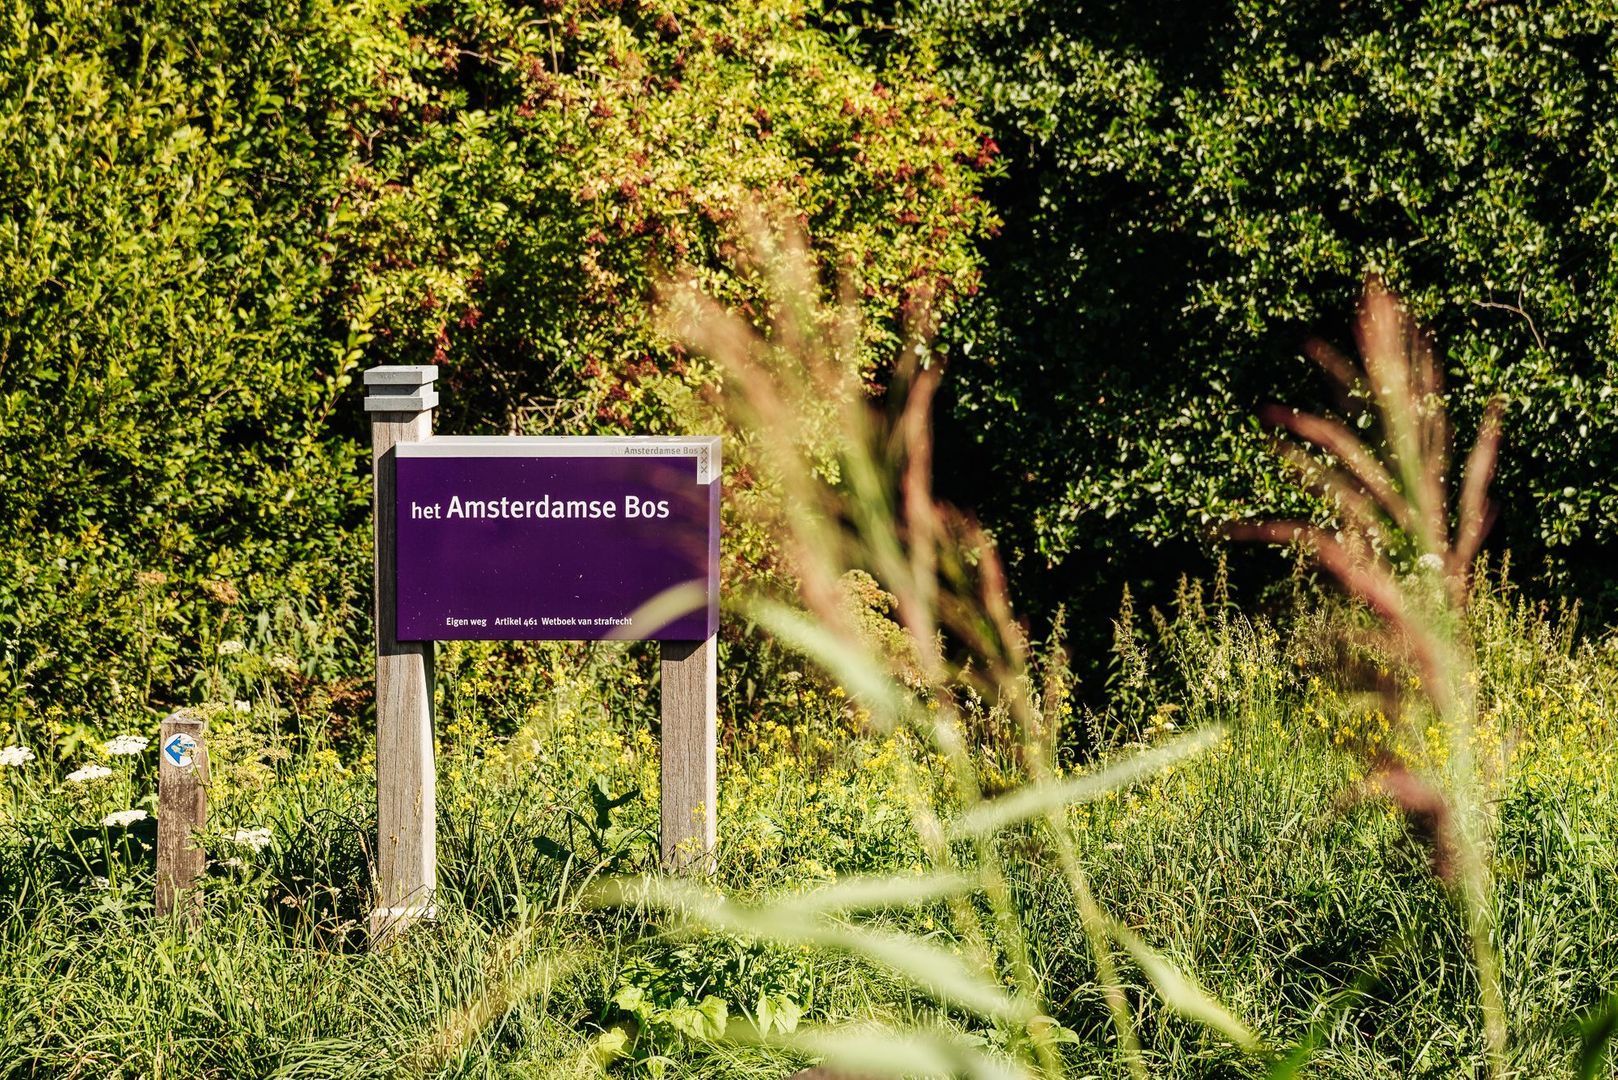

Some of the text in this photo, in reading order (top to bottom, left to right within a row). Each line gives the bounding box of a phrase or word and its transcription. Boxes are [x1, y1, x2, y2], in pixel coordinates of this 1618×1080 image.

[624, 447, 698, 455] Amsterdamse Bos
[412, 494, 670, 519] het Amsterdamse Bos
[446, 616, 633, 628] Eigen weg Artikel 461 Wetboek van strafrecht
